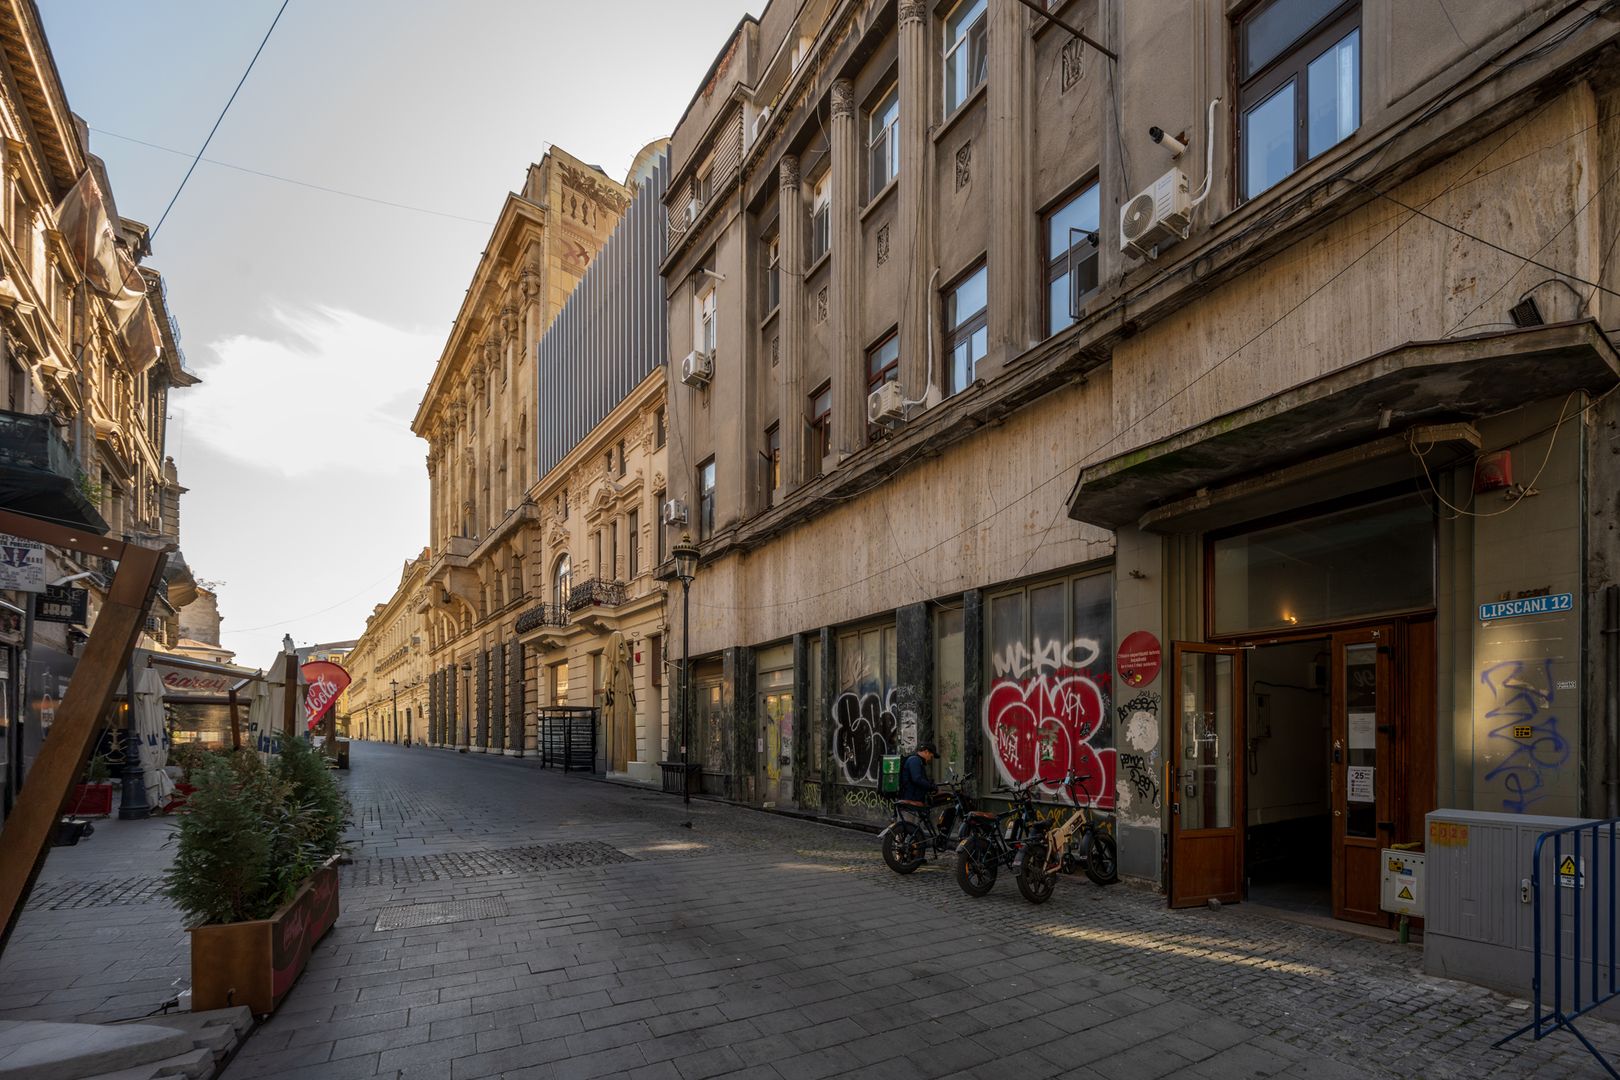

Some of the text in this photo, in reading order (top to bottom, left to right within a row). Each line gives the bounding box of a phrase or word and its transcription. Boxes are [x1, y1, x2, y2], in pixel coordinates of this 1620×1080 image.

[1482, 595, 1569, 618] LIPSCANI 12
[306, 673, 338, 712] Cola
[1354, 771, 1365, 780] 25
